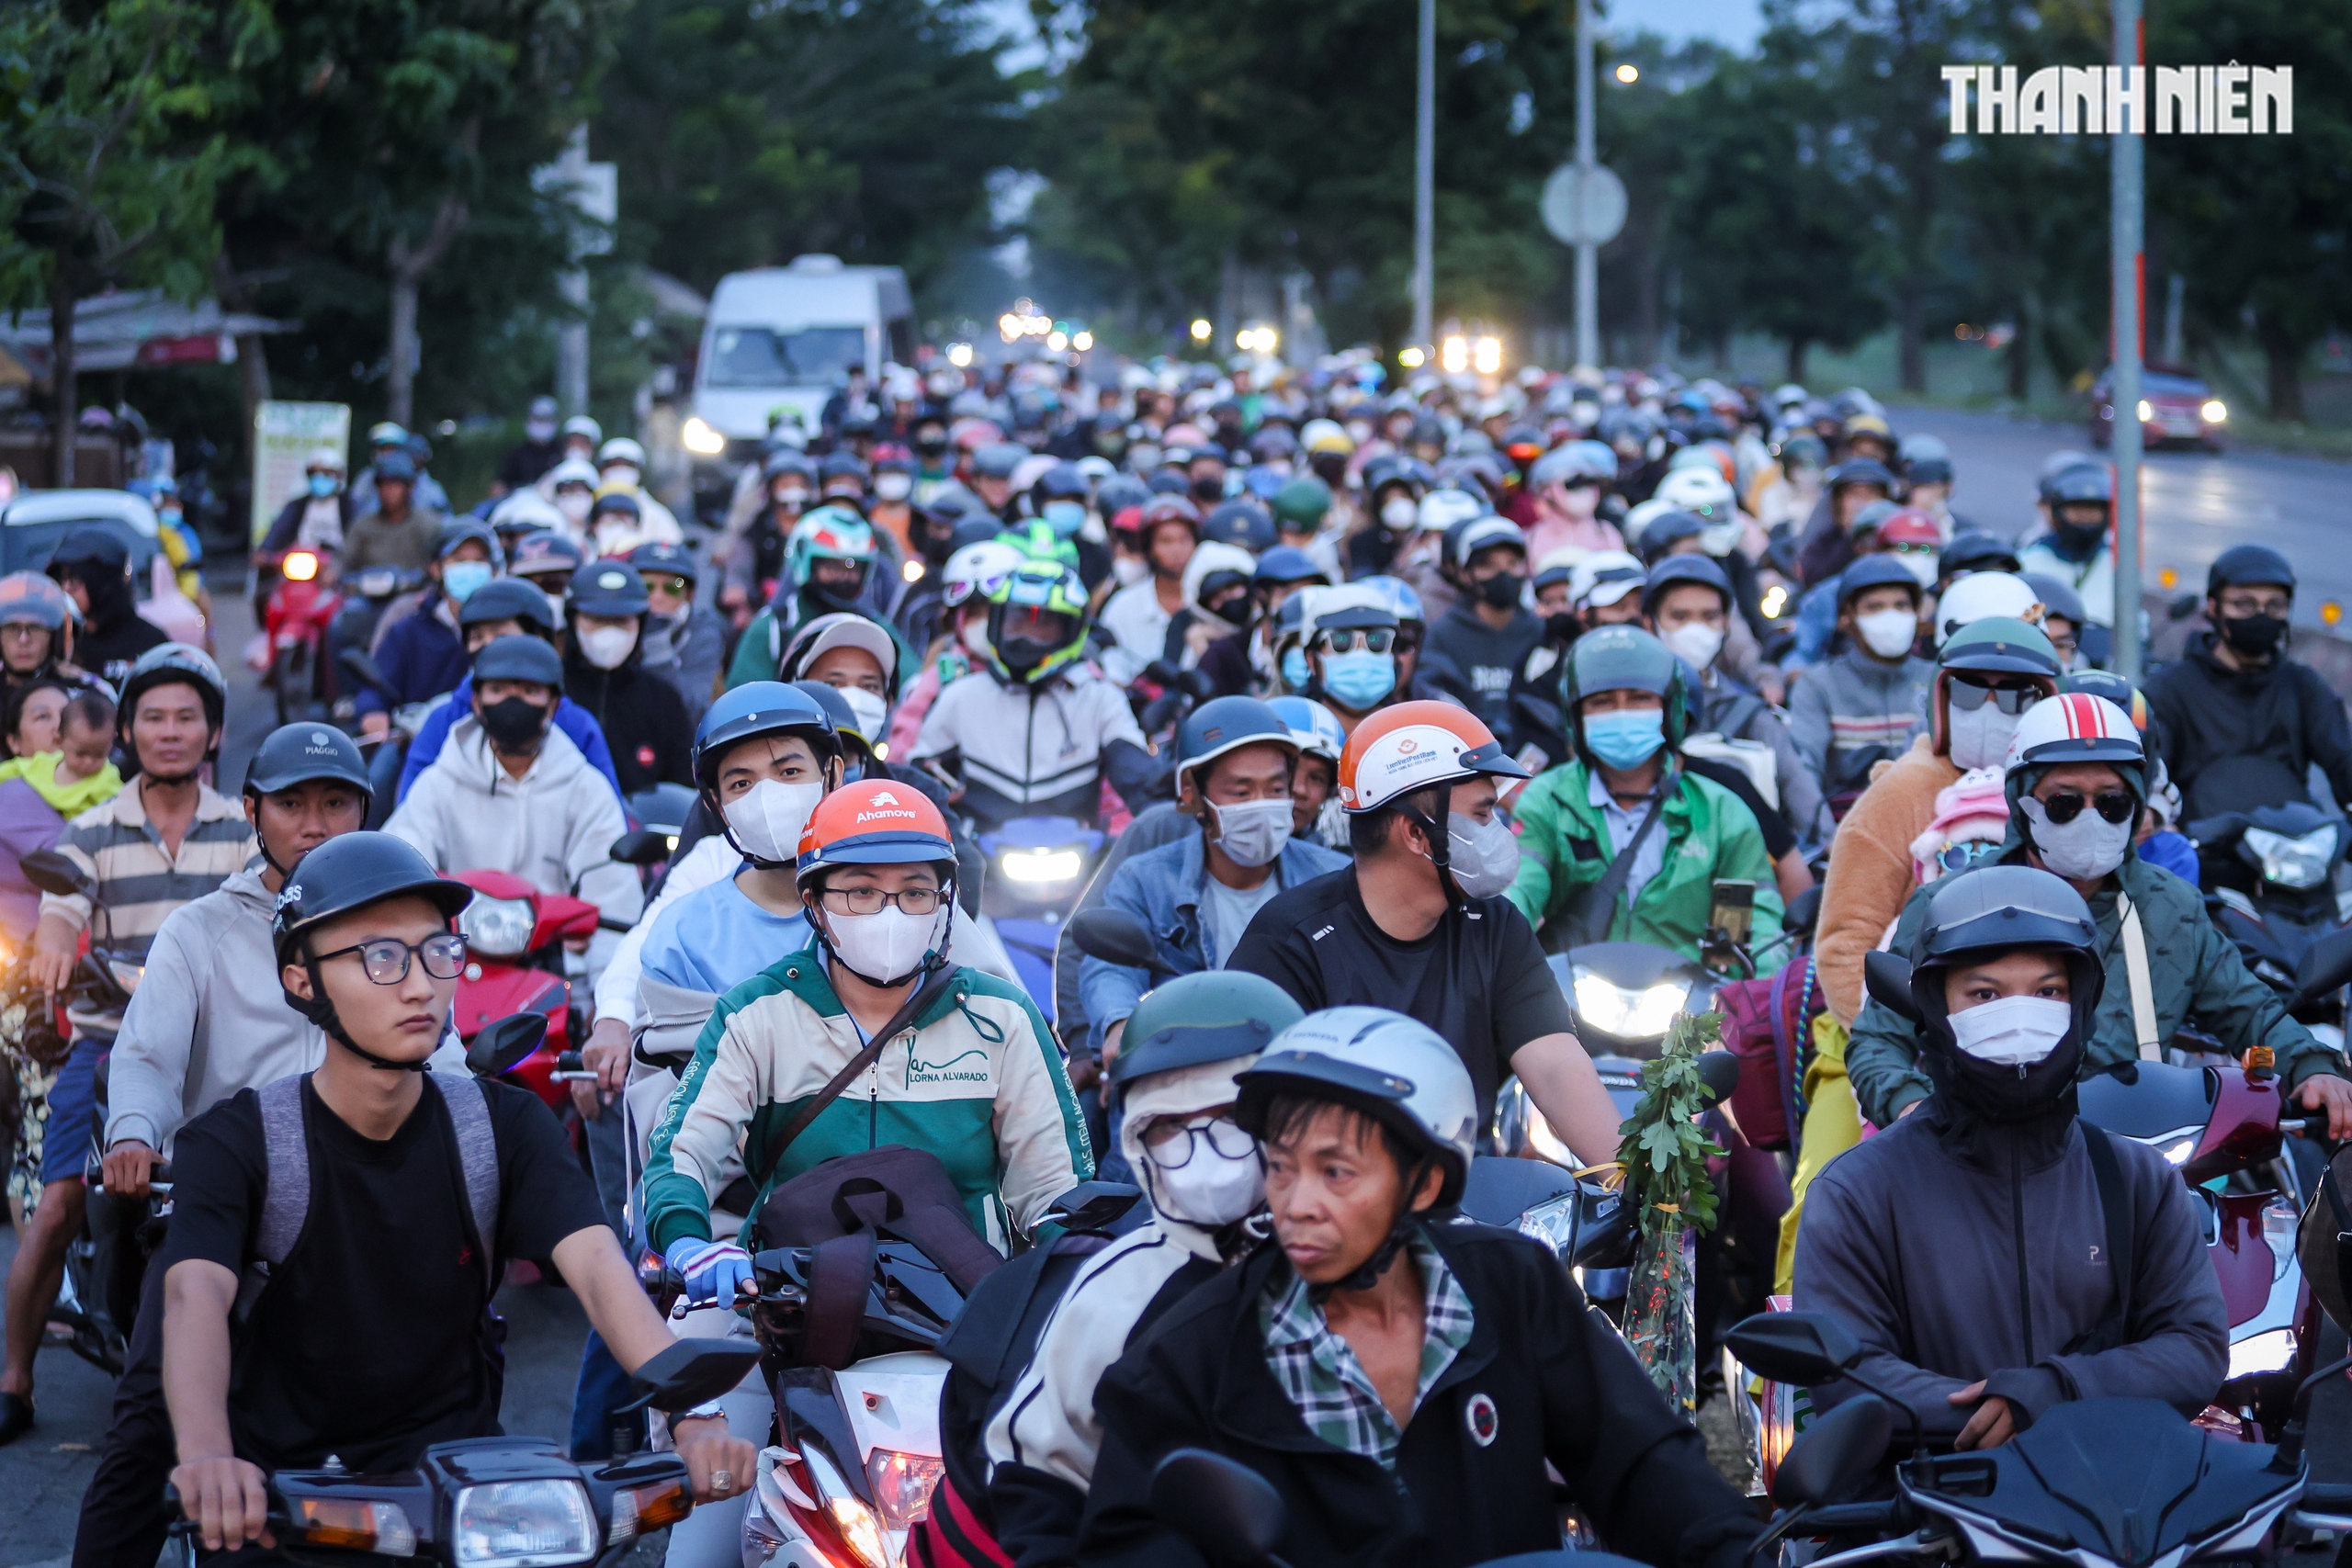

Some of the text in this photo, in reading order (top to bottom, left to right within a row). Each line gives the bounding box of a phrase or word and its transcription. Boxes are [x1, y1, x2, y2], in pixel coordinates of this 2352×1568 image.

[305, 746, 338, 756] PIAGGIO
[856, 809, 916, 825] Ahamove
[910, 1072, 989, 1083] LORNA ALVARADO
[1599, 1076, 1638, 1088] ONDA
